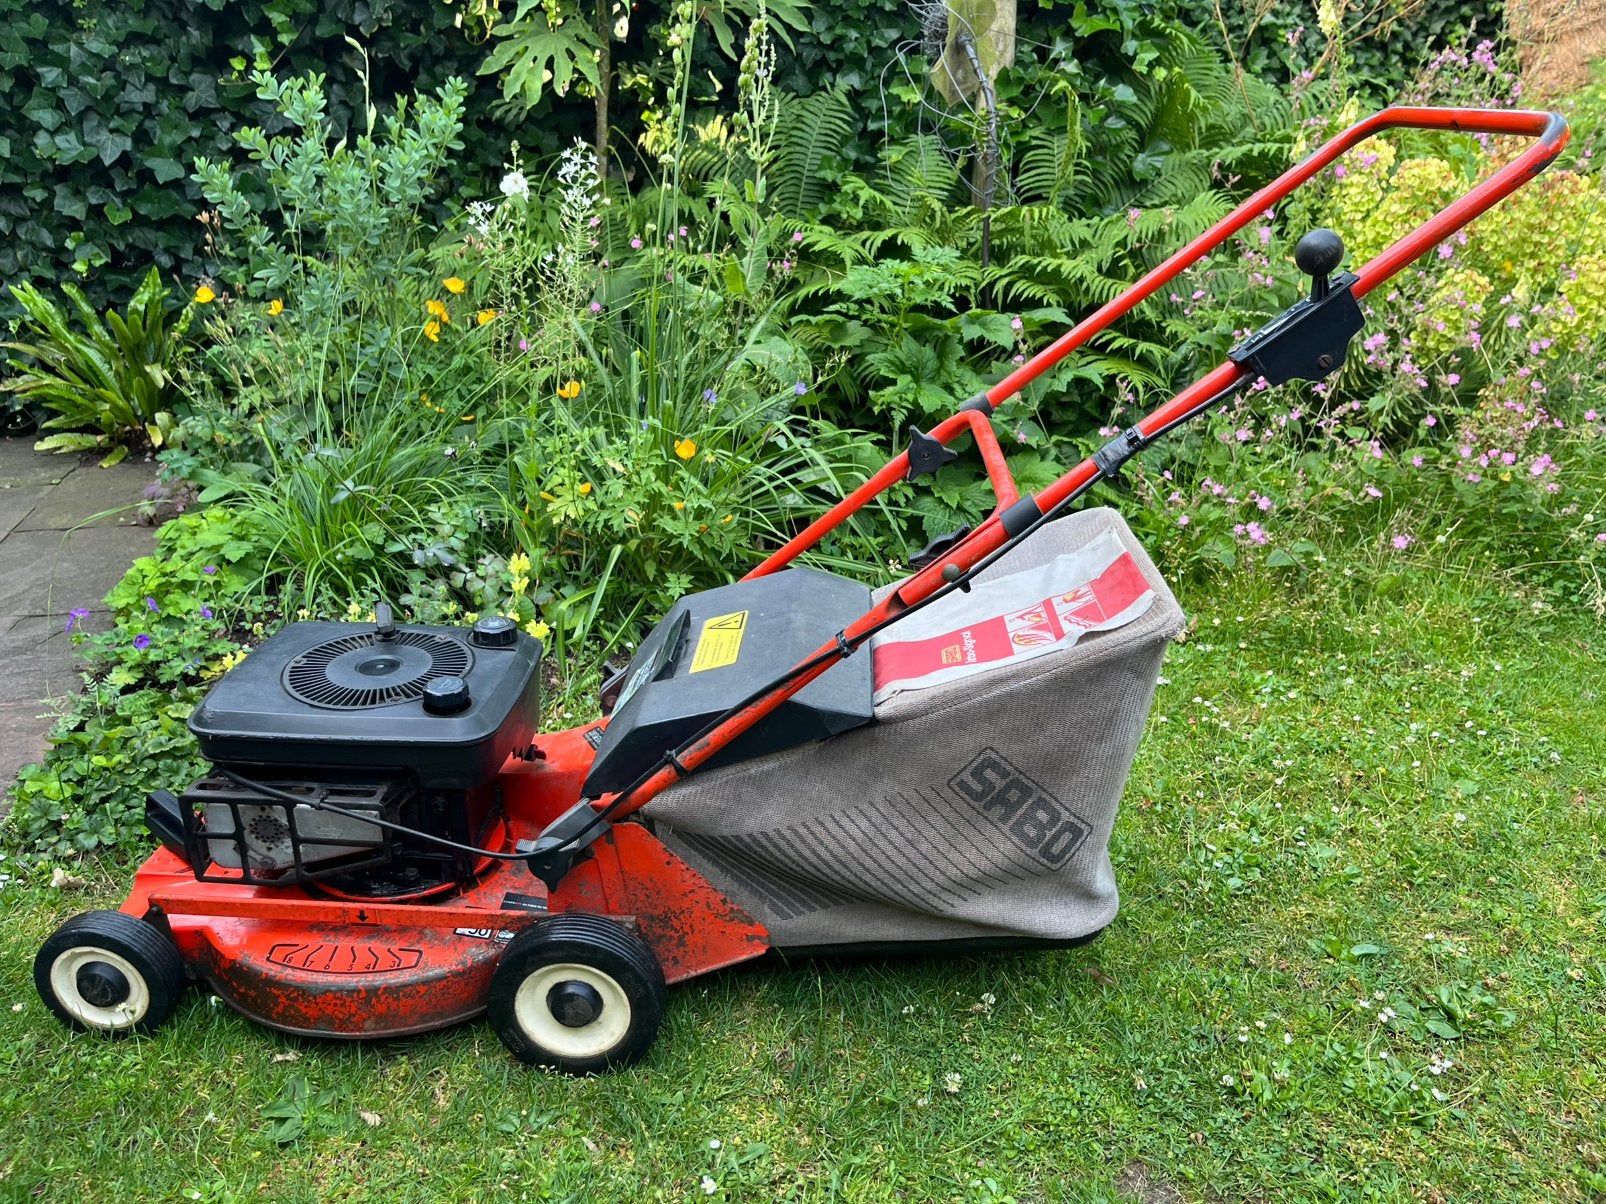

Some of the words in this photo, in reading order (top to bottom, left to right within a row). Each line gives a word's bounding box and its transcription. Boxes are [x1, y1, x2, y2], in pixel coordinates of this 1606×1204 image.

[955, 756, 1084, 865] SABO
[286, 956, 293, 964] 8
[306, 960, 314, 968] 7
[323, 962, 331, 970] 6
[347, 963, 353, 971] 5
[364, 962, 371, 970] 4
[389, 960, 396, 968] 3
